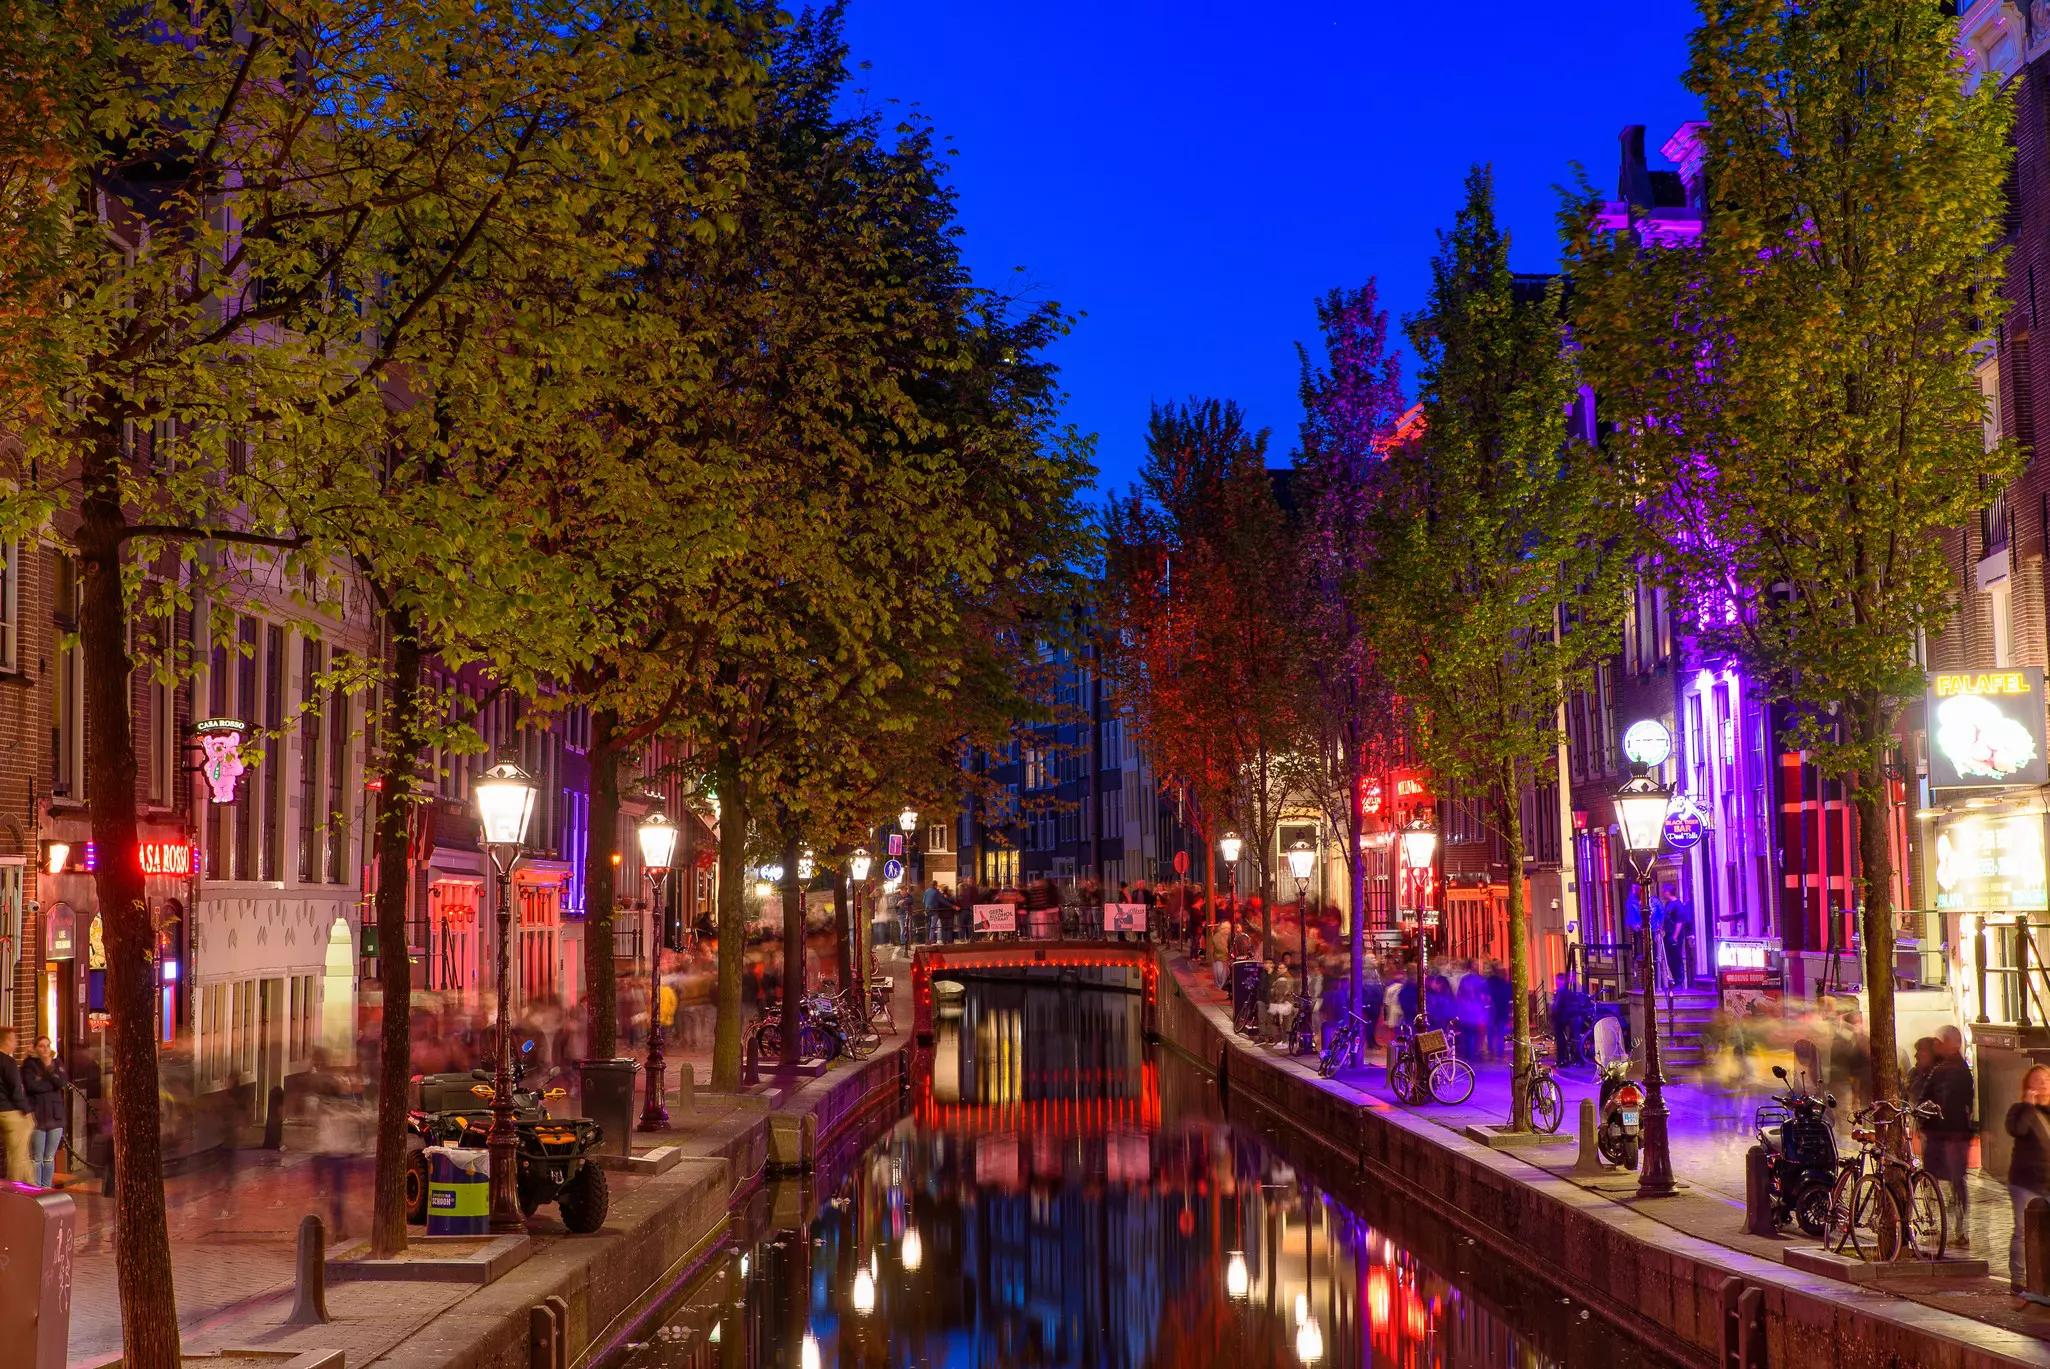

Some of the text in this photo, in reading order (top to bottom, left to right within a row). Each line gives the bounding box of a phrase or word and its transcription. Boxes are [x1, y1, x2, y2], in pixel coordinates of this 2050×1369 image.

[1937, 673, 2031, 696] FALAFEL
[198, 720, 245, 729] CASA ROSSO
[139, 843, 190, 874] ASA ROSSO
[990, 911, 1013, 919] ALCOHOL
